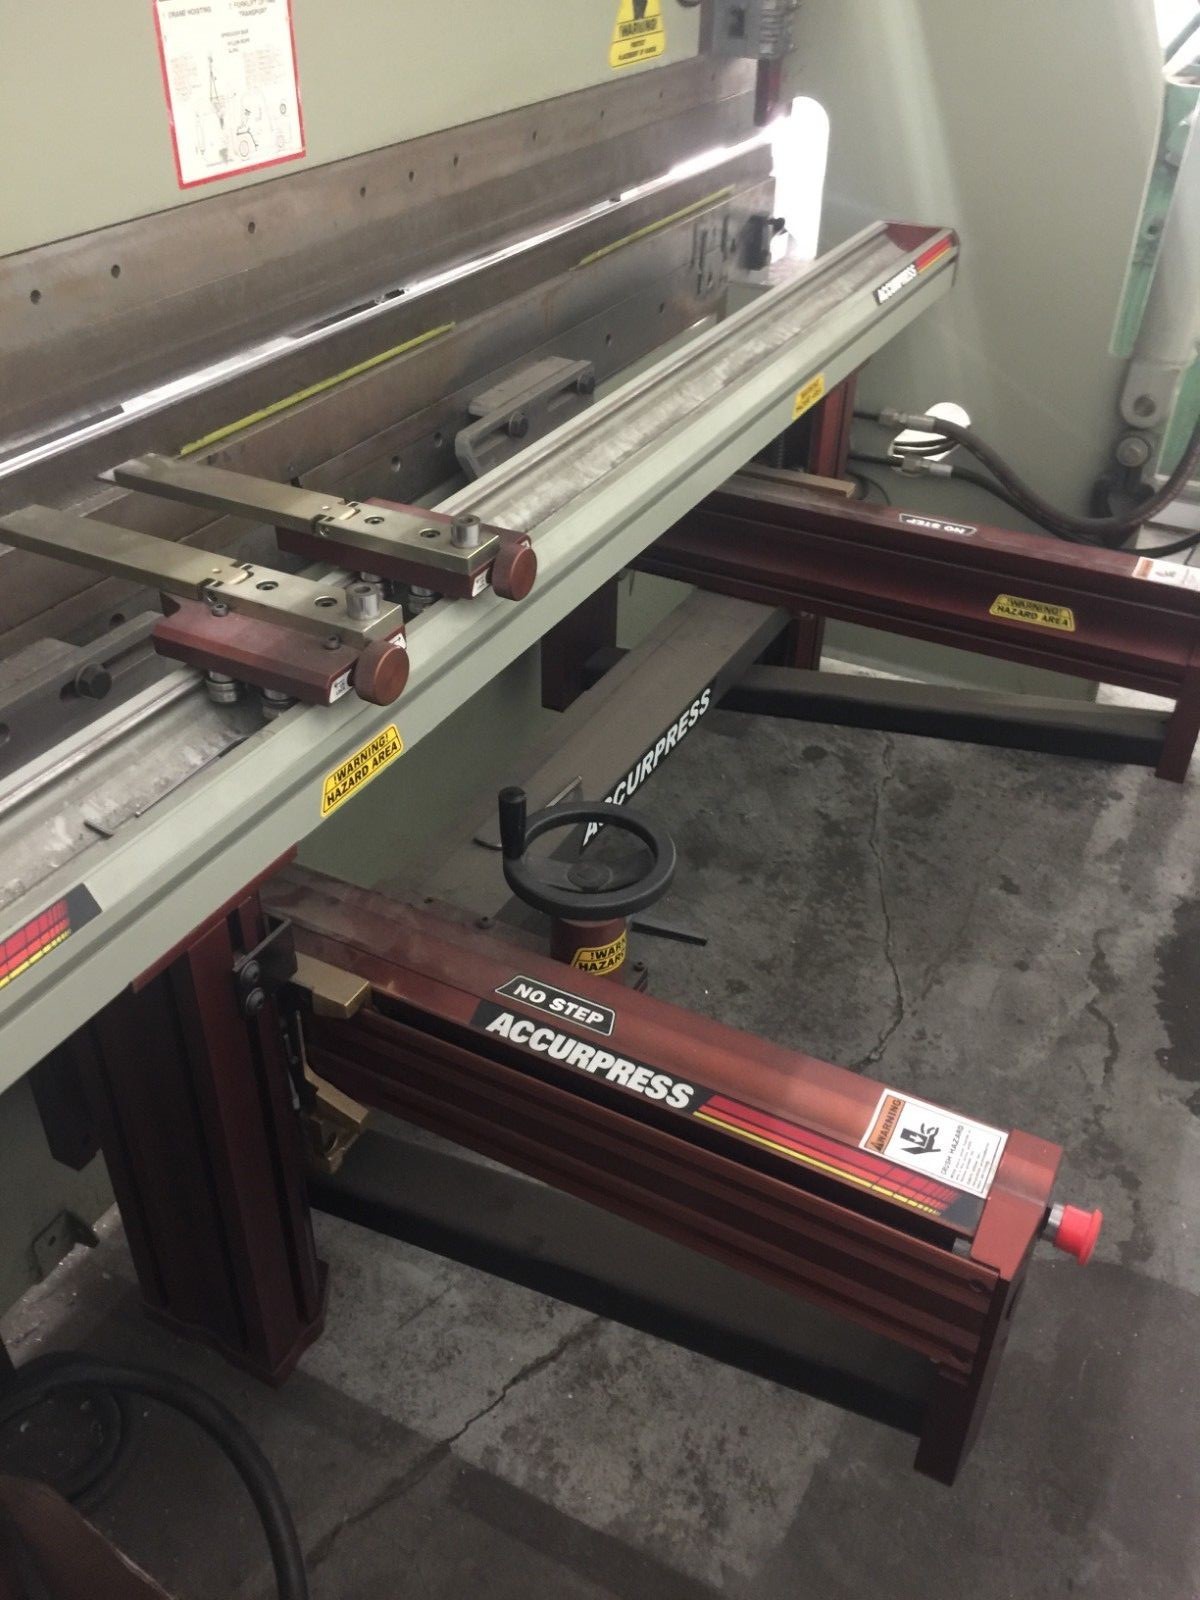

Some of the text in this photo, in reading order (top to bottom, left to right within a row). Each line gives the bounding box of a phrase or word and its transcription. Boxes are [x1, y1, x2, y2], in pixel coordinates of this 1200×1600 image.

[997, 605, 1039, 620] HAZARD
[327, 740, 398, 806] HAZARD AREA
[513, 983, 605, 1025] NO STEP
[485, 1012, 694, 1109] ACCURPRESS
[877, 1098, 902, 1145] WARNING
[947, 1125, 965, 1154] HAZARD
